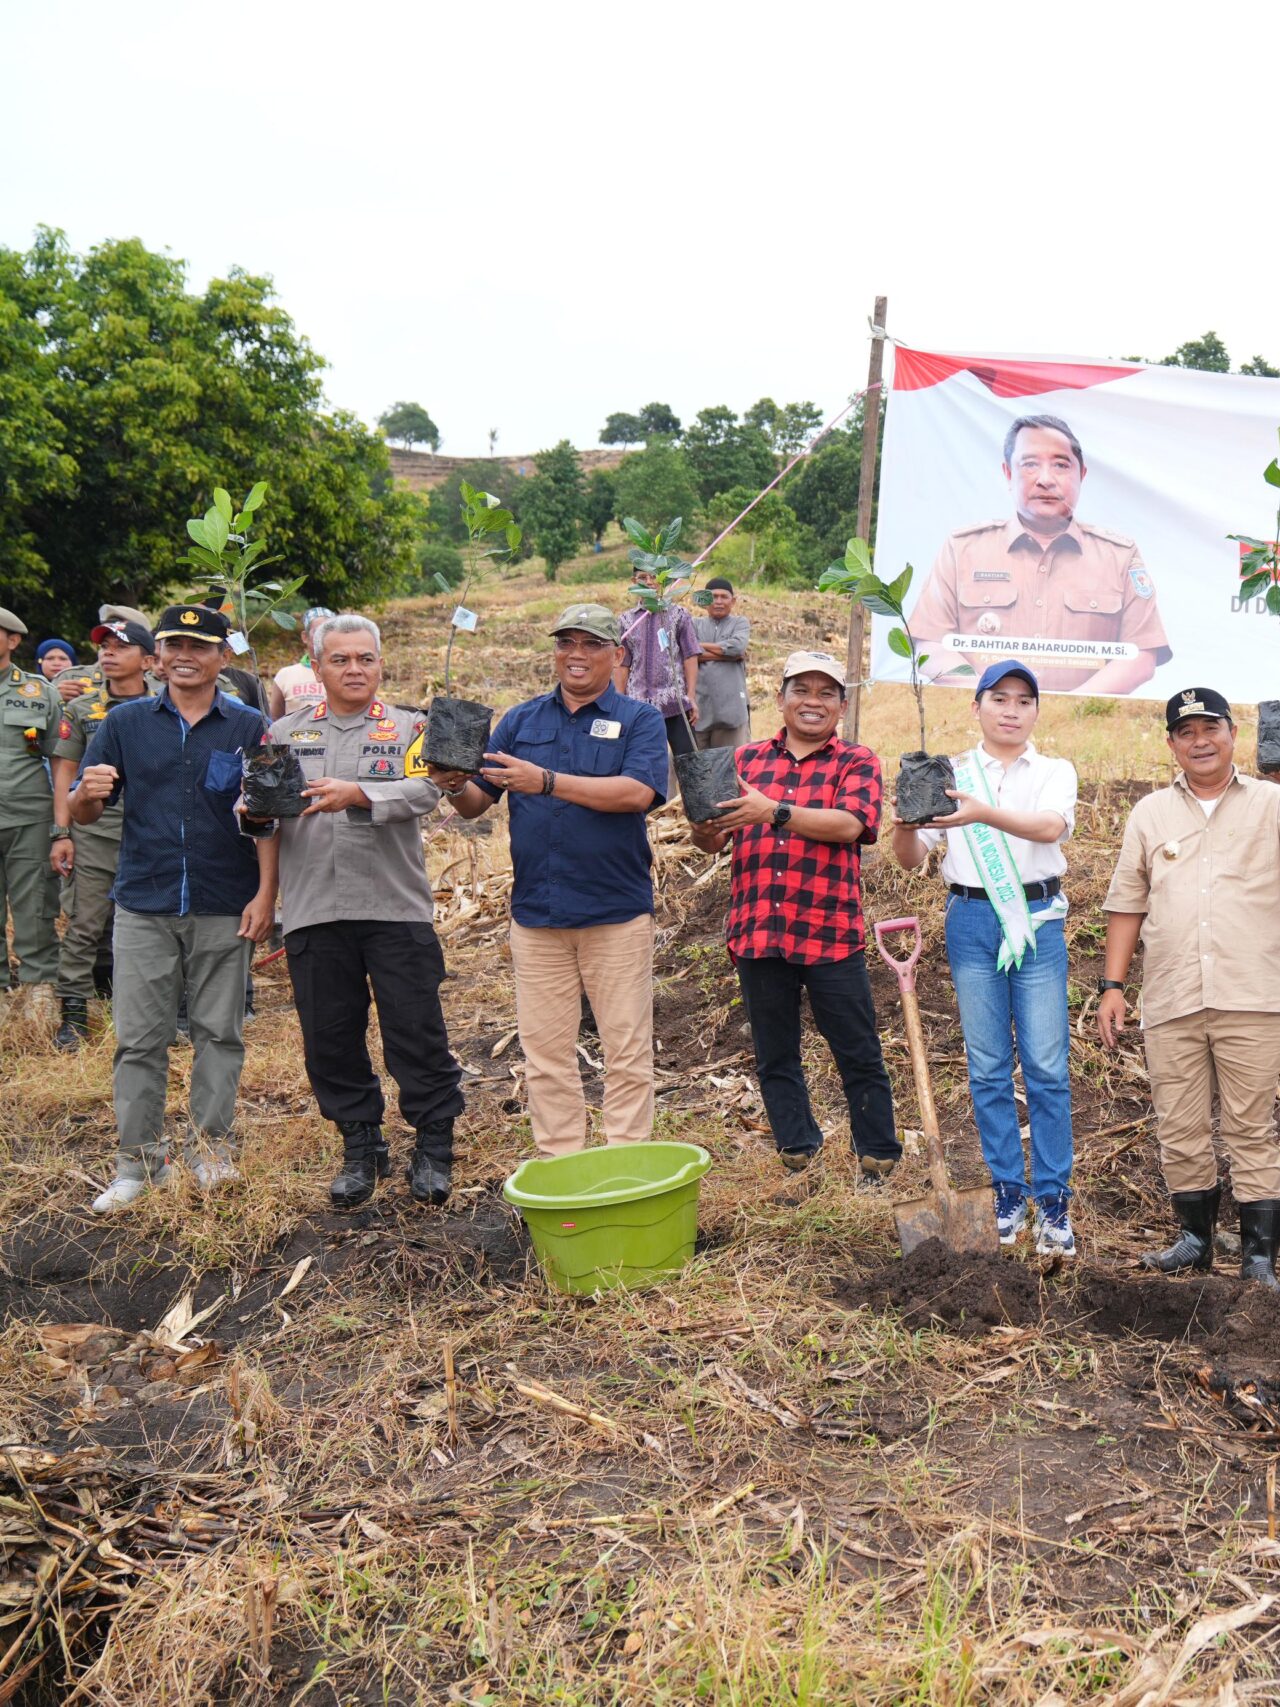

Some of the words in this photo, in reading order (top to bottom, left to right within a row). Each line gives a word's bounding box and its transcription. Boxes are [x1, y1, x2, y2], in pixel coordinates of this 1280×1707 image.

[1231, 596, 1249, 613] DI
[952, 638, 969, 648] Dr.
[971, 640, 1019, 651] BAHTIAR
[1022, 642, 1099, 655] BAHARUDDIN,
[1101, 646, 1128, 656] M.Si.
[6, 699, 28, 709] POL
[31, 700, 45, 711] PP
[362, 745, 402, 756] POLRI
[980, 842, 1008, 883] INDONESIA
[994, 882, 1016, 903] 2023
